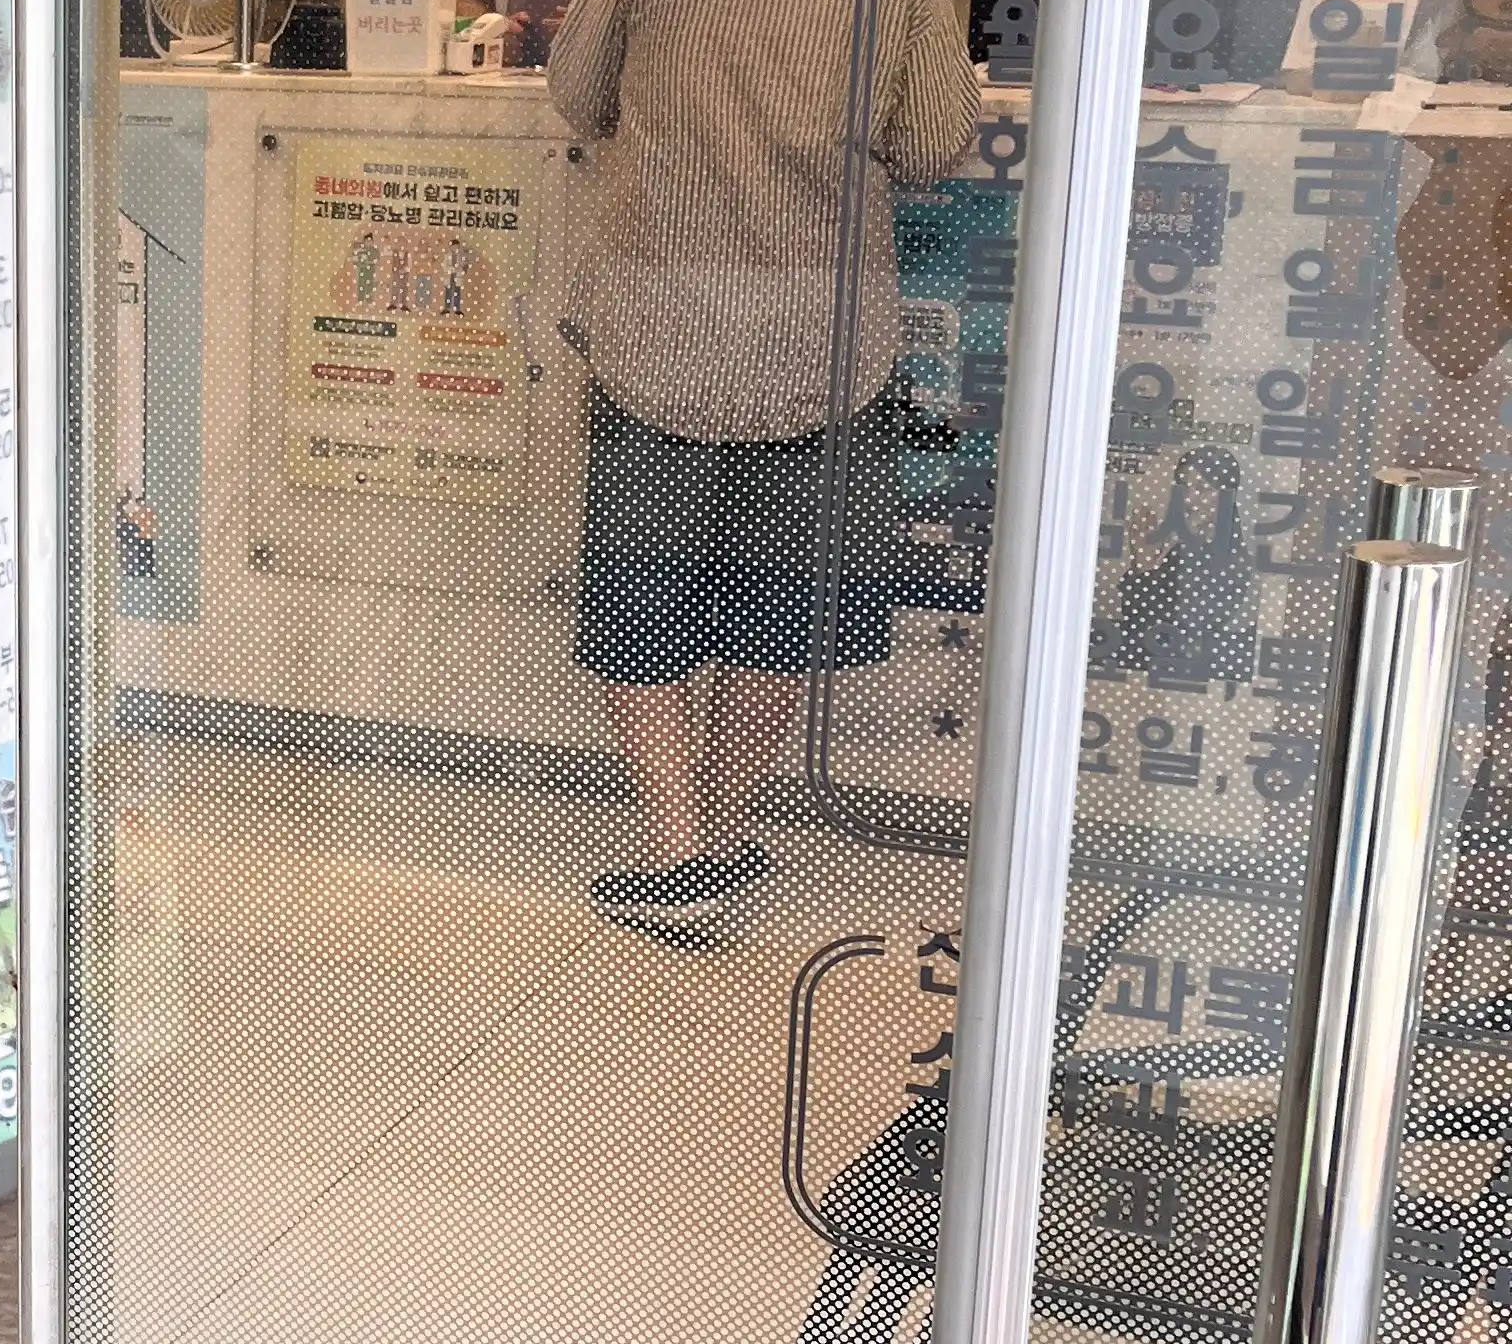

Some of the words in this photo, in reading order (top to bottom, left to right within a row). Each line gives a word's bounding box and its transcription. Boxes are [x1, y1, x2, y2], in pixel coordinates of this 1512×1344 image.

[424, 182, 459, 203] 쉽고
[464, 187, 521, 206] 편하게
[427, 207, 519, 231] 관리하세요
